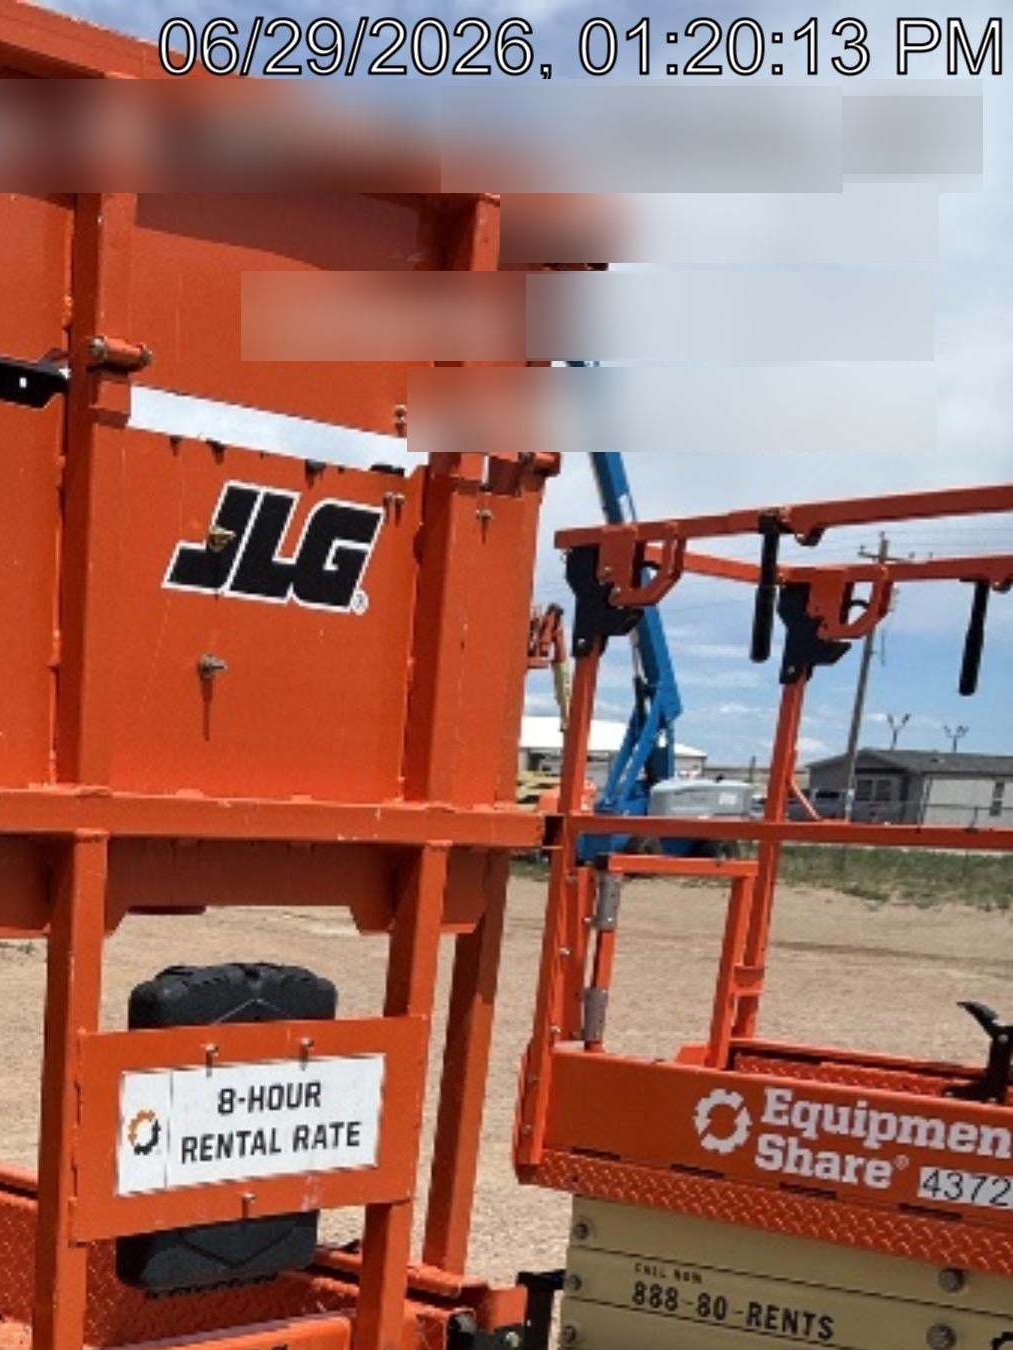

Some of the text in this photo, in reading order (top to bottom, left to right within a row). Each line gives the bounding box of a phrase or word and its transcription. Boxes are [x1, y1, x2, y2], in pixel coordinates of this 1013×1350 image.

[161, 480, 385, 614] JLG
[217, 1081, 321, 1115] 8-HOUR
[181, 1121, 361, 1164] RENTAL RATE
